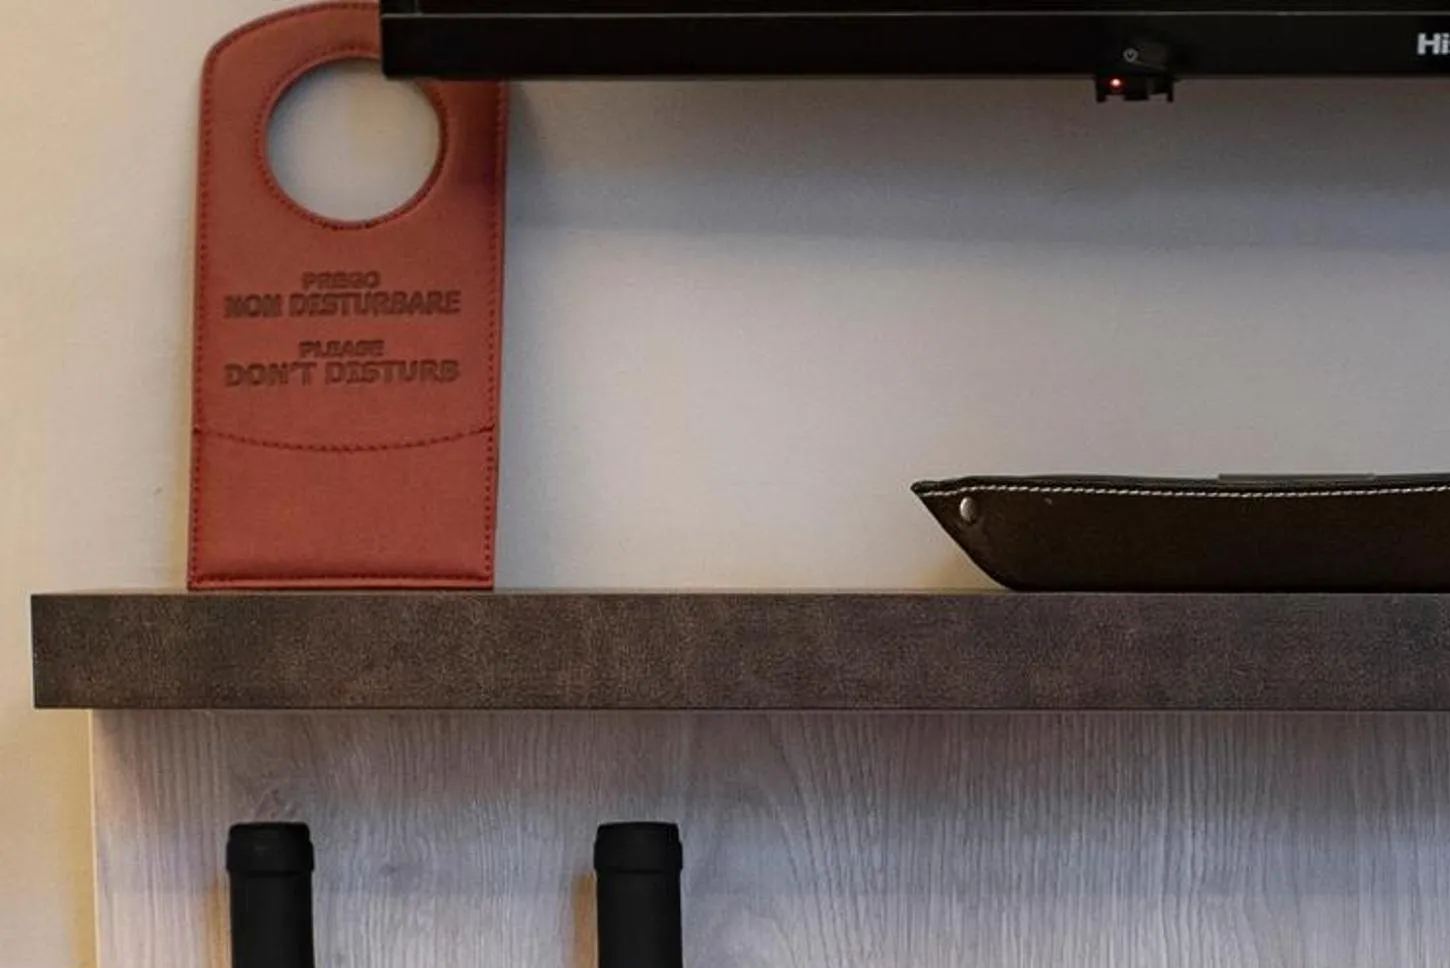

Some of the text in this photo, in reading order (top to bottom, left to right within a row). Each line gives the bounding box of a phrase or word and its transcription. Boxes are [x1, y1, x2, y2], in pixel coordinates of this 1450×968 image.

[301, 270, 381, 290] PREGO
[224, 290, 462, 318] NON DISTURBARE
[300, 339, 385, 358] PLEASE
[224, 359, 460, 387] DON'T DISTURB
